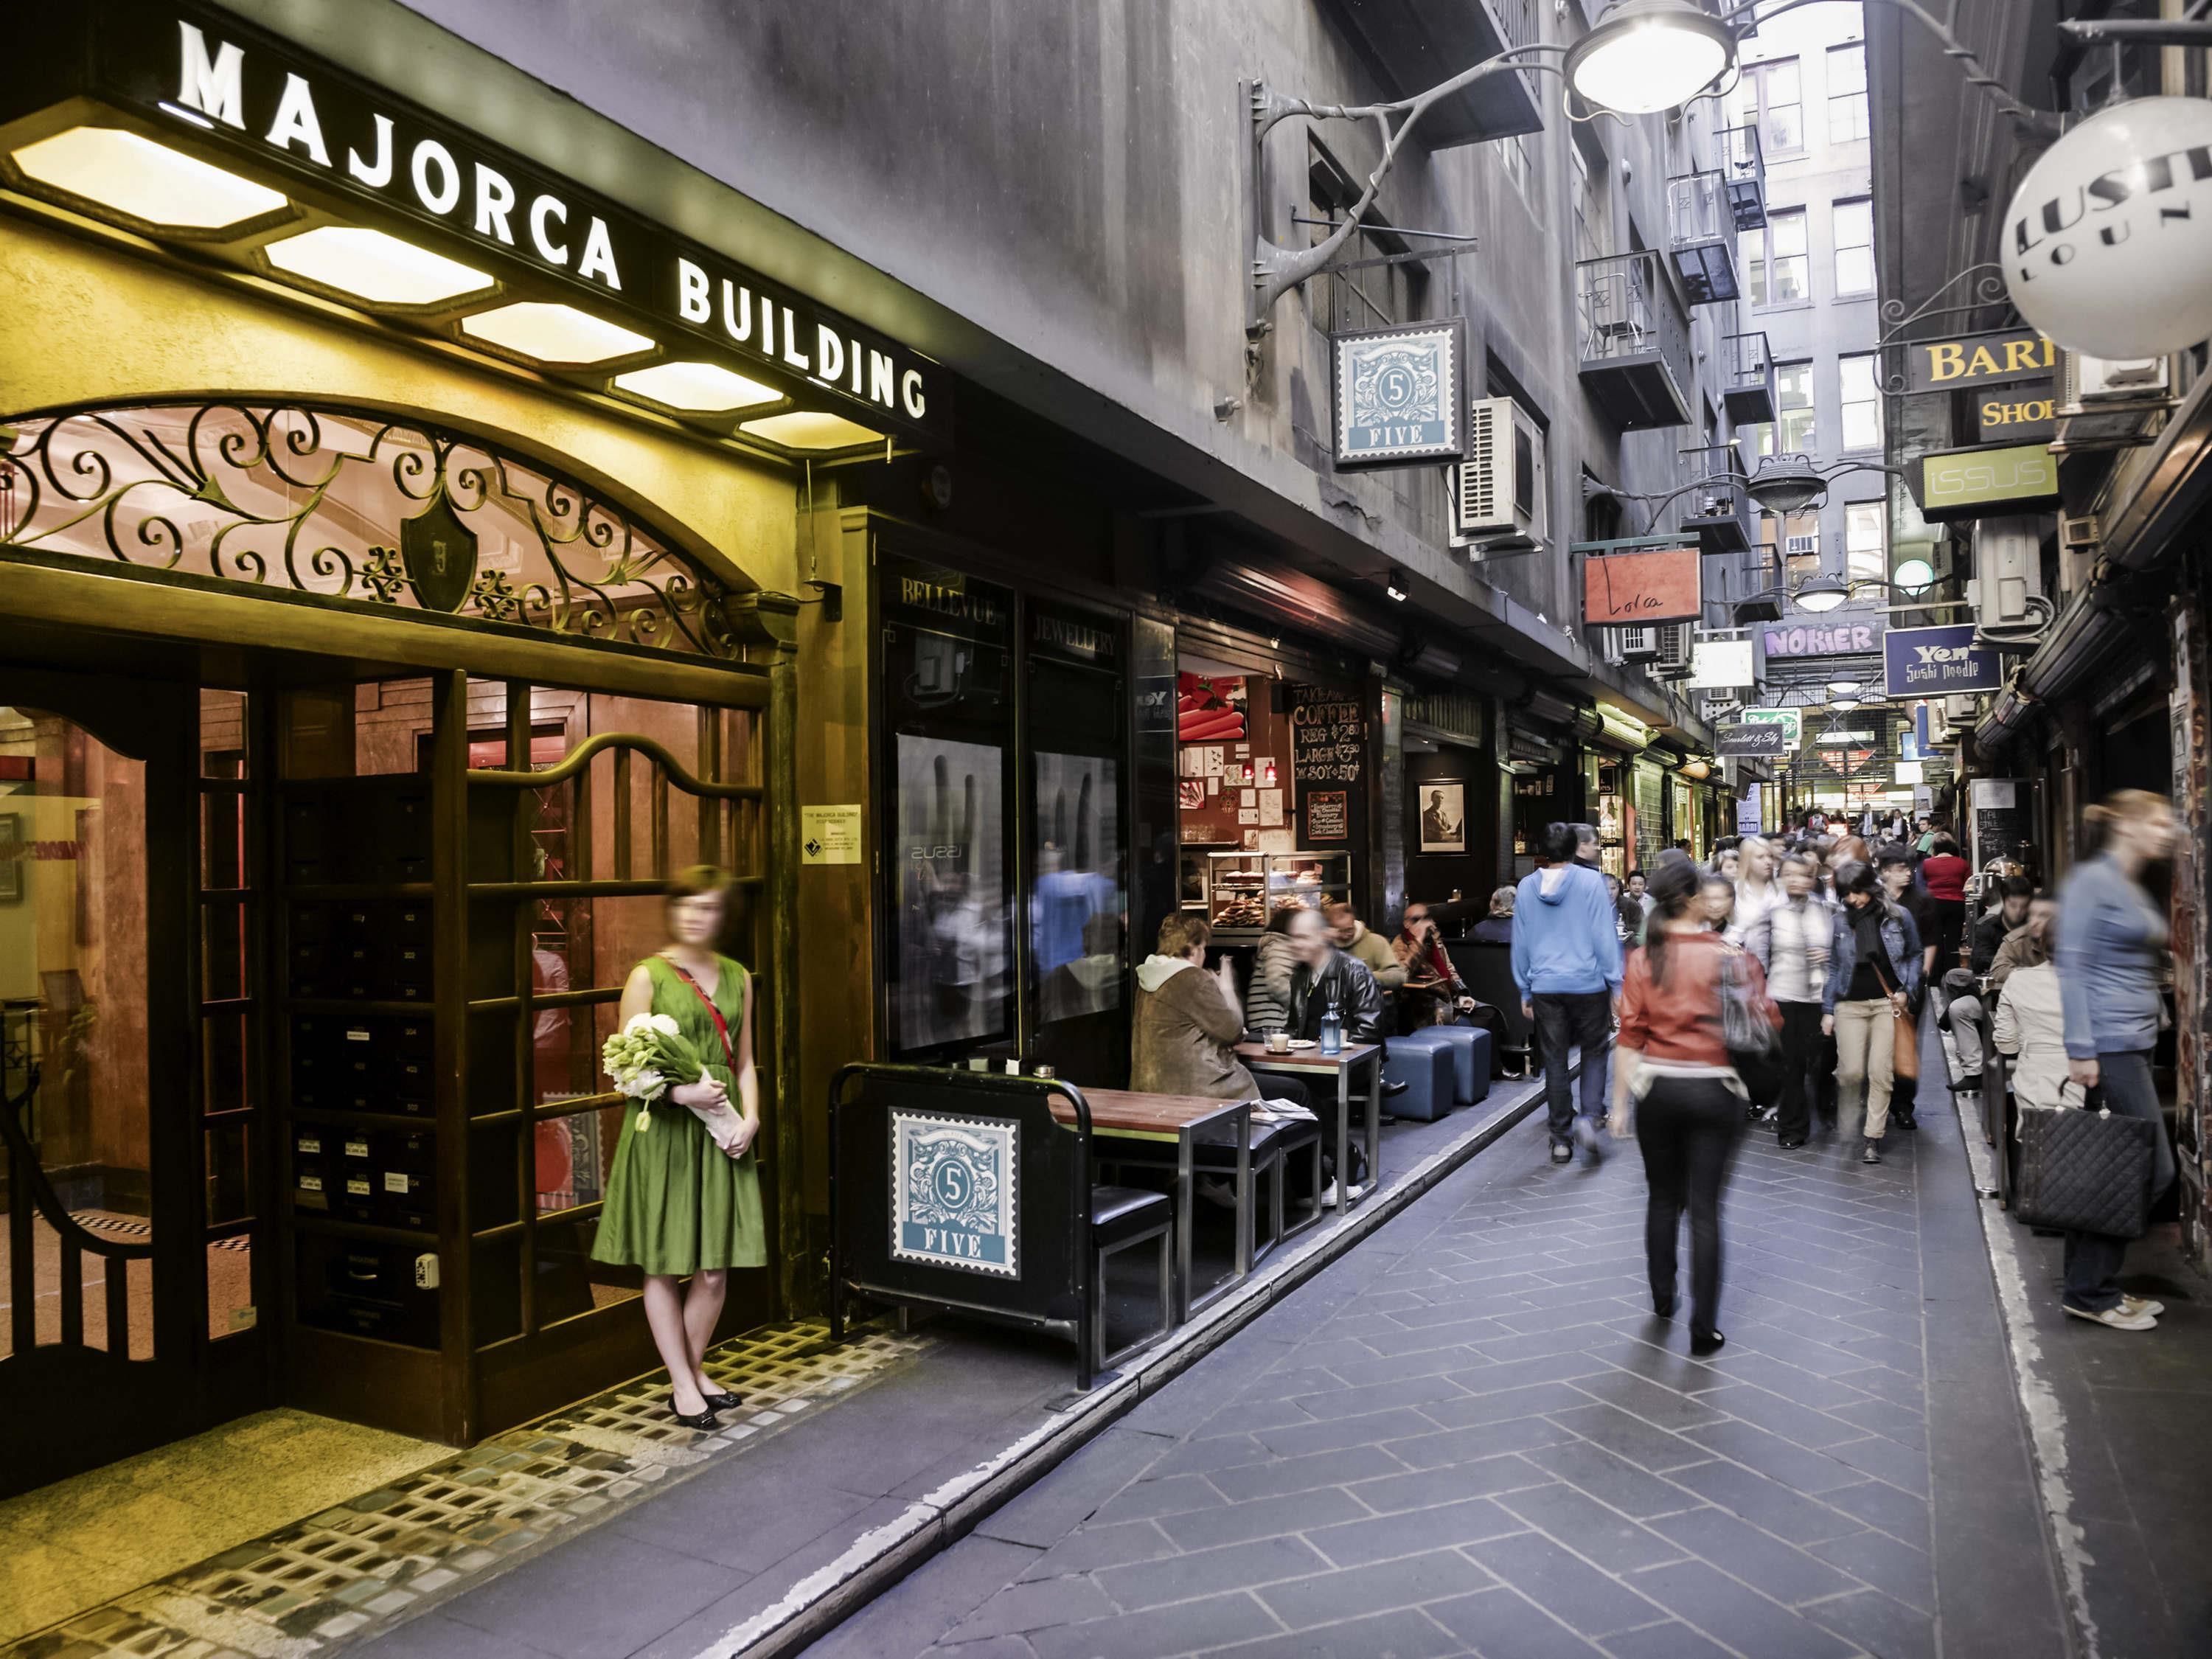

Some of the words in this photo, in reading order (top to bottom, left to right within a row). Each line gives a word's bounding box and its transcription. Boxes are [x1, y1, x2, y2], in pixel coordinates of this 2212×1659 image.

[178, 20, 622, 291] MAJORCA
[678, 257, 926, 419] BUILDING
[1388, 374, 1404, 401] 5
[1369, 424, 1423, 448] FIVE
[901, 577, 997, 625] BELLEVUE
[1032, 616, 1116, 655] JEWELLERY
[1912, 645, 1969, 663] Yen
[1906, 664, 1937, 683] Sushi
[1294, 703, 1360, 725] COFFEE
[1300, 728, 1327, 743] REG
[1295, 747, 1334, 763] LARGE
[1307, 765, 1333, 781] SOY
[945, 1167, 961, 1201] 5
[924, 1227, 981, 1259] FIVE
